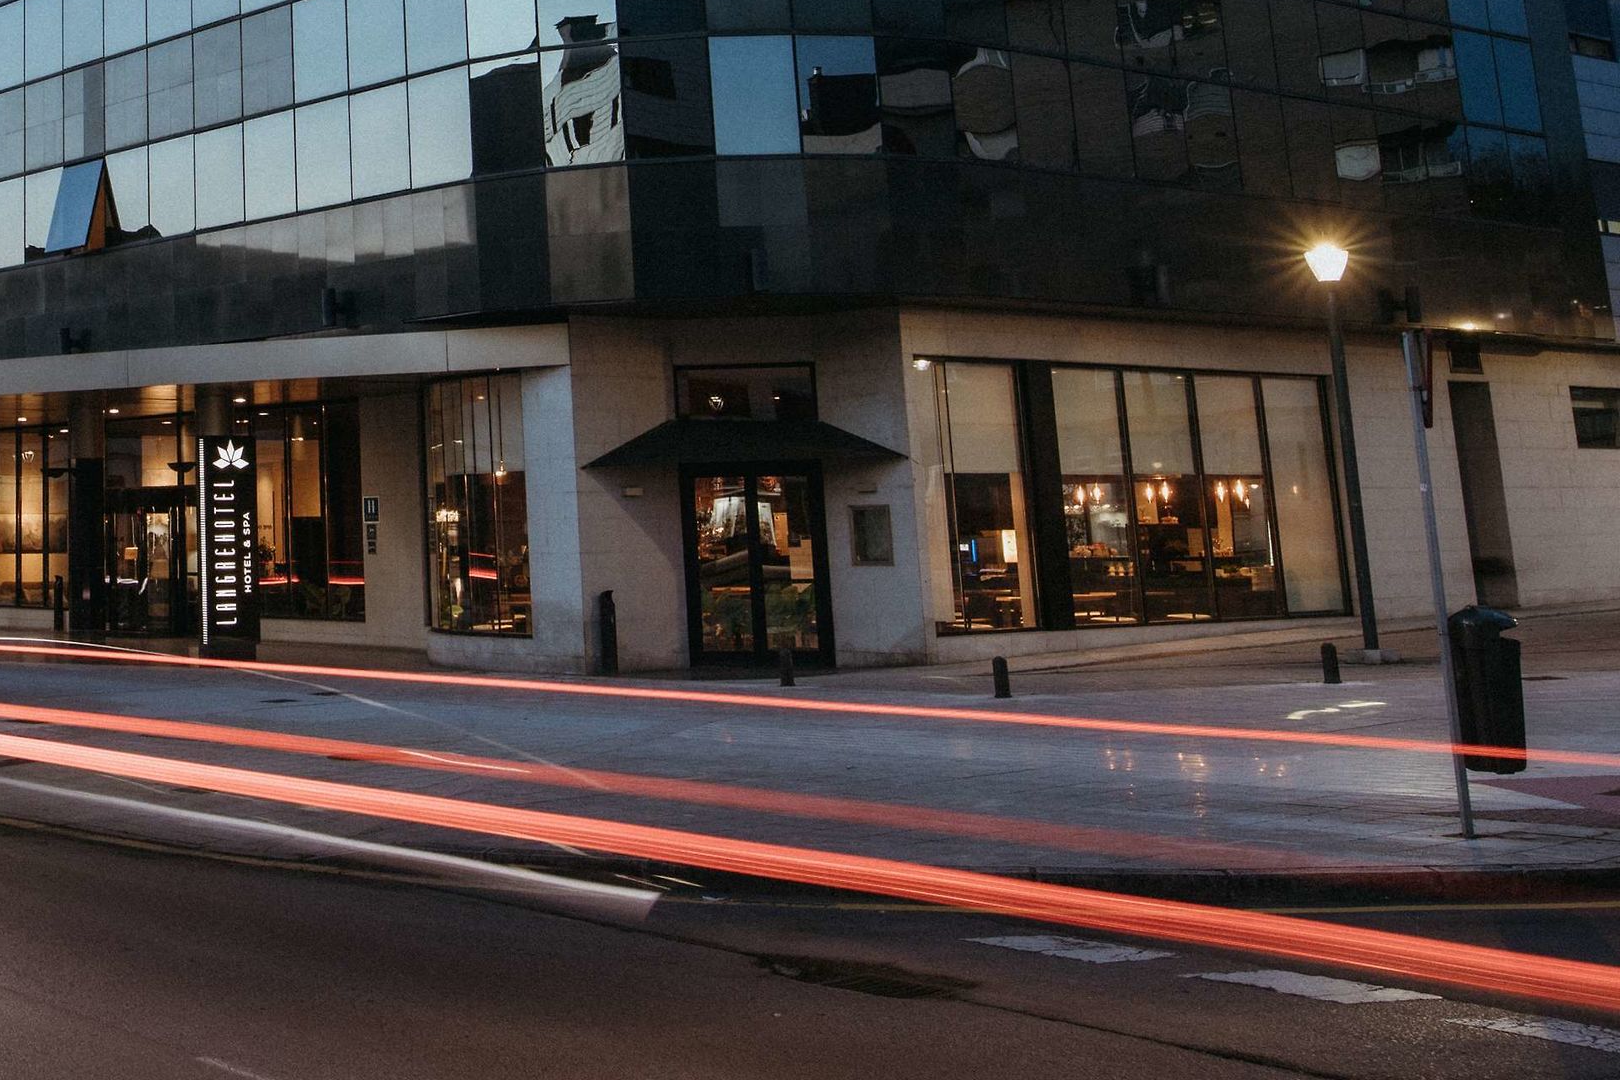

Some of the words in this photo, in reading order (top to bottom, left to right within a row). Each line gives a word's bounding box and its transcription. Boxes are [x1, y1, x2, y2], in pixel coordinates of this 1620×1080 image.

[242, 512, 251, 535] SPA
[213, 480, 237, 625] LANGREHOTEL
[243, 539, 251, 548] &
[243, 552, 252, 593] HOTEL
